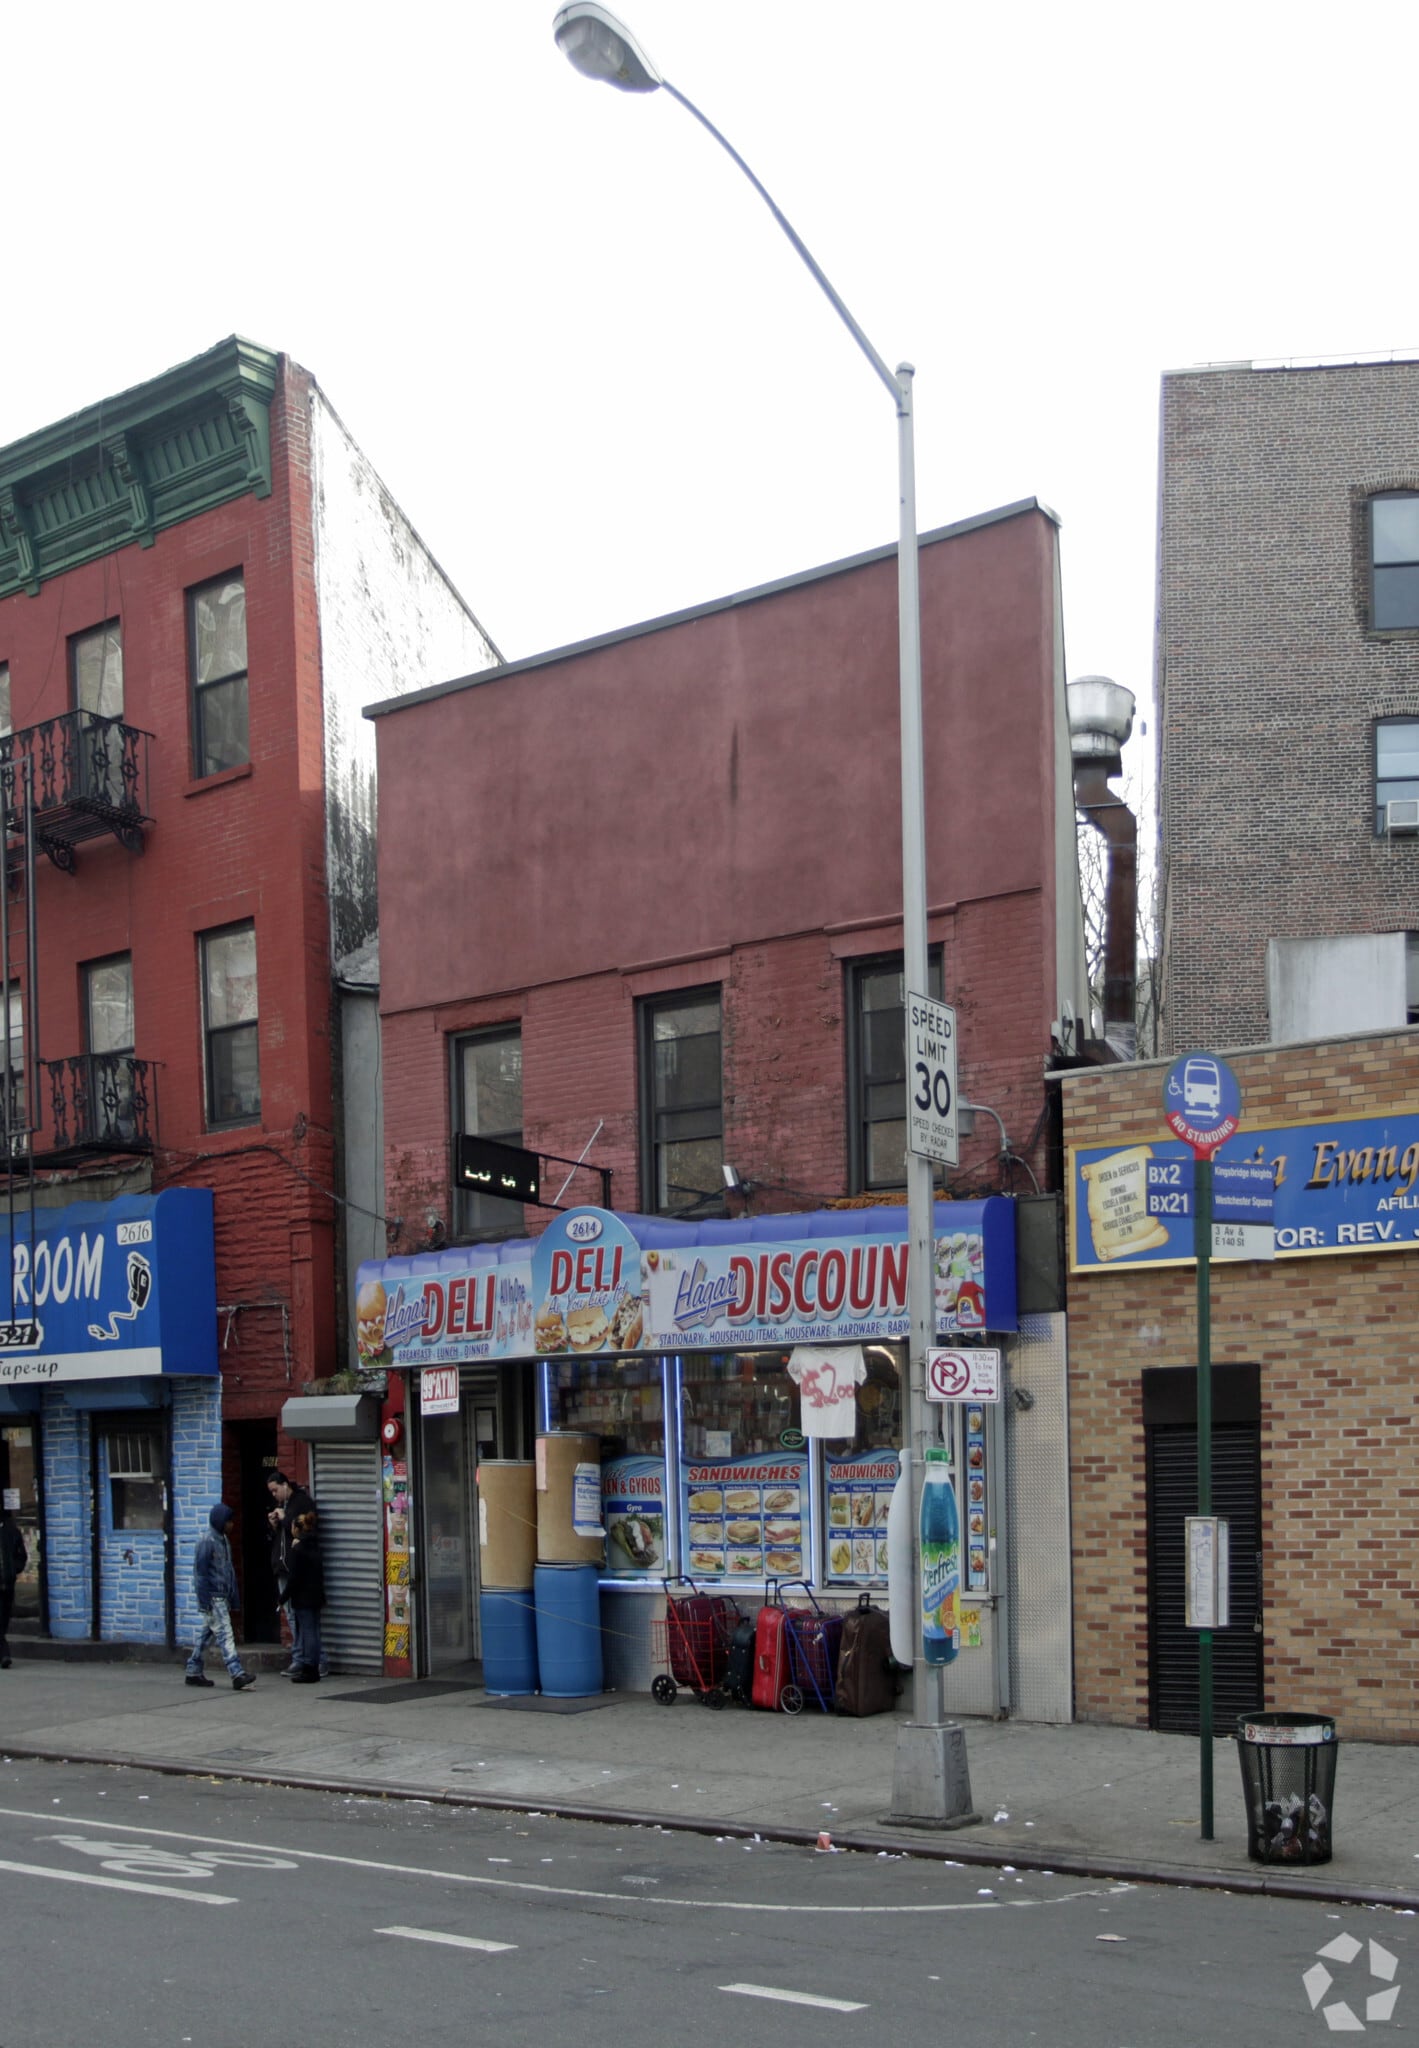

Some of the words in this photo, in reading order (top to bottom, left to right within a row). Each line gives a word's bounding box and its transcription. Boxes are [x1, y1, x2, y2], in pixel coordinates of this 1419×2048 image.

[912, 1006, 951, 1038] SPEED
[916, 1035, 947, 1063] LIMIT
[915, 1062, 950, 1117] 30
[912, 1116, 929, 1131] SPEED
[932, 1122, 954, 1138] CHECKED
[1171, 1115, 1186, 1132] NO
[1186, 1119, 1234, 1144] STANDING
[920, 1132, 927, 1143] BY
[930, 1135, 947, 1149] RADAR
[1148, 1164, 1181, 1185] BX2
[1214, 1166, 1249, 1179] Kingsbridge
[1250, 1168, 1272, 1180] Heights
[1149, 1193, 1189, 1213] BX21
[1214, 1195, 1250, 1206] Westchester
[1252, 1196, 1273, 1208] Square
[1376, 1196, 1419, 1212] AFILI
[120, 1223, 149, 1243] 2616
[572, 1222, 597, 1237] 2614
[1215, 1226, 1220, 1235] 3
[1224, 1226, 1234, 1235] Av
[1238, 1227, 1244, 1236] &
[1338, 1220, 1400, 1243] REV.
[1215, 1237, 1220, 1246] E
[1222, 1237, 1235, 1247] 140
[1237, 1237, 1245, 1247] St
[13, 1232, 104, 1307] ROOM
[550, 1245, 623, 1296] DELI
[674, 1257, 737, 1320] Hagar
[727, 1243, 910, 1317] DISCOUN
[420, 1274, 497, 1337] DELI
[660, 1332, 701, 1345] STATIONARY
[710, 1329, 753, 1343] HOUSEHOLD
[756, 1327, 777, 1341] ITEMS
[785, 1322, 831, 1338] HOUSEWARE
[838, 1322, 881, 1335] HARDWARE
[399, 1348, 432, 1361] BREAKFAST
[437, 1346, 459, 1358] LUNCH
[464, 1343, 489, 1357] DINNER
[435, 1369, 456, 1399] ATM
[688, 1465, 801, 1481] SANDWICHES
[830, 1463, 896, 1479] SANDWICHES
[629, 1477, 661, 1494] GYROS
[626, 1503, 642, 1512] Gyro
